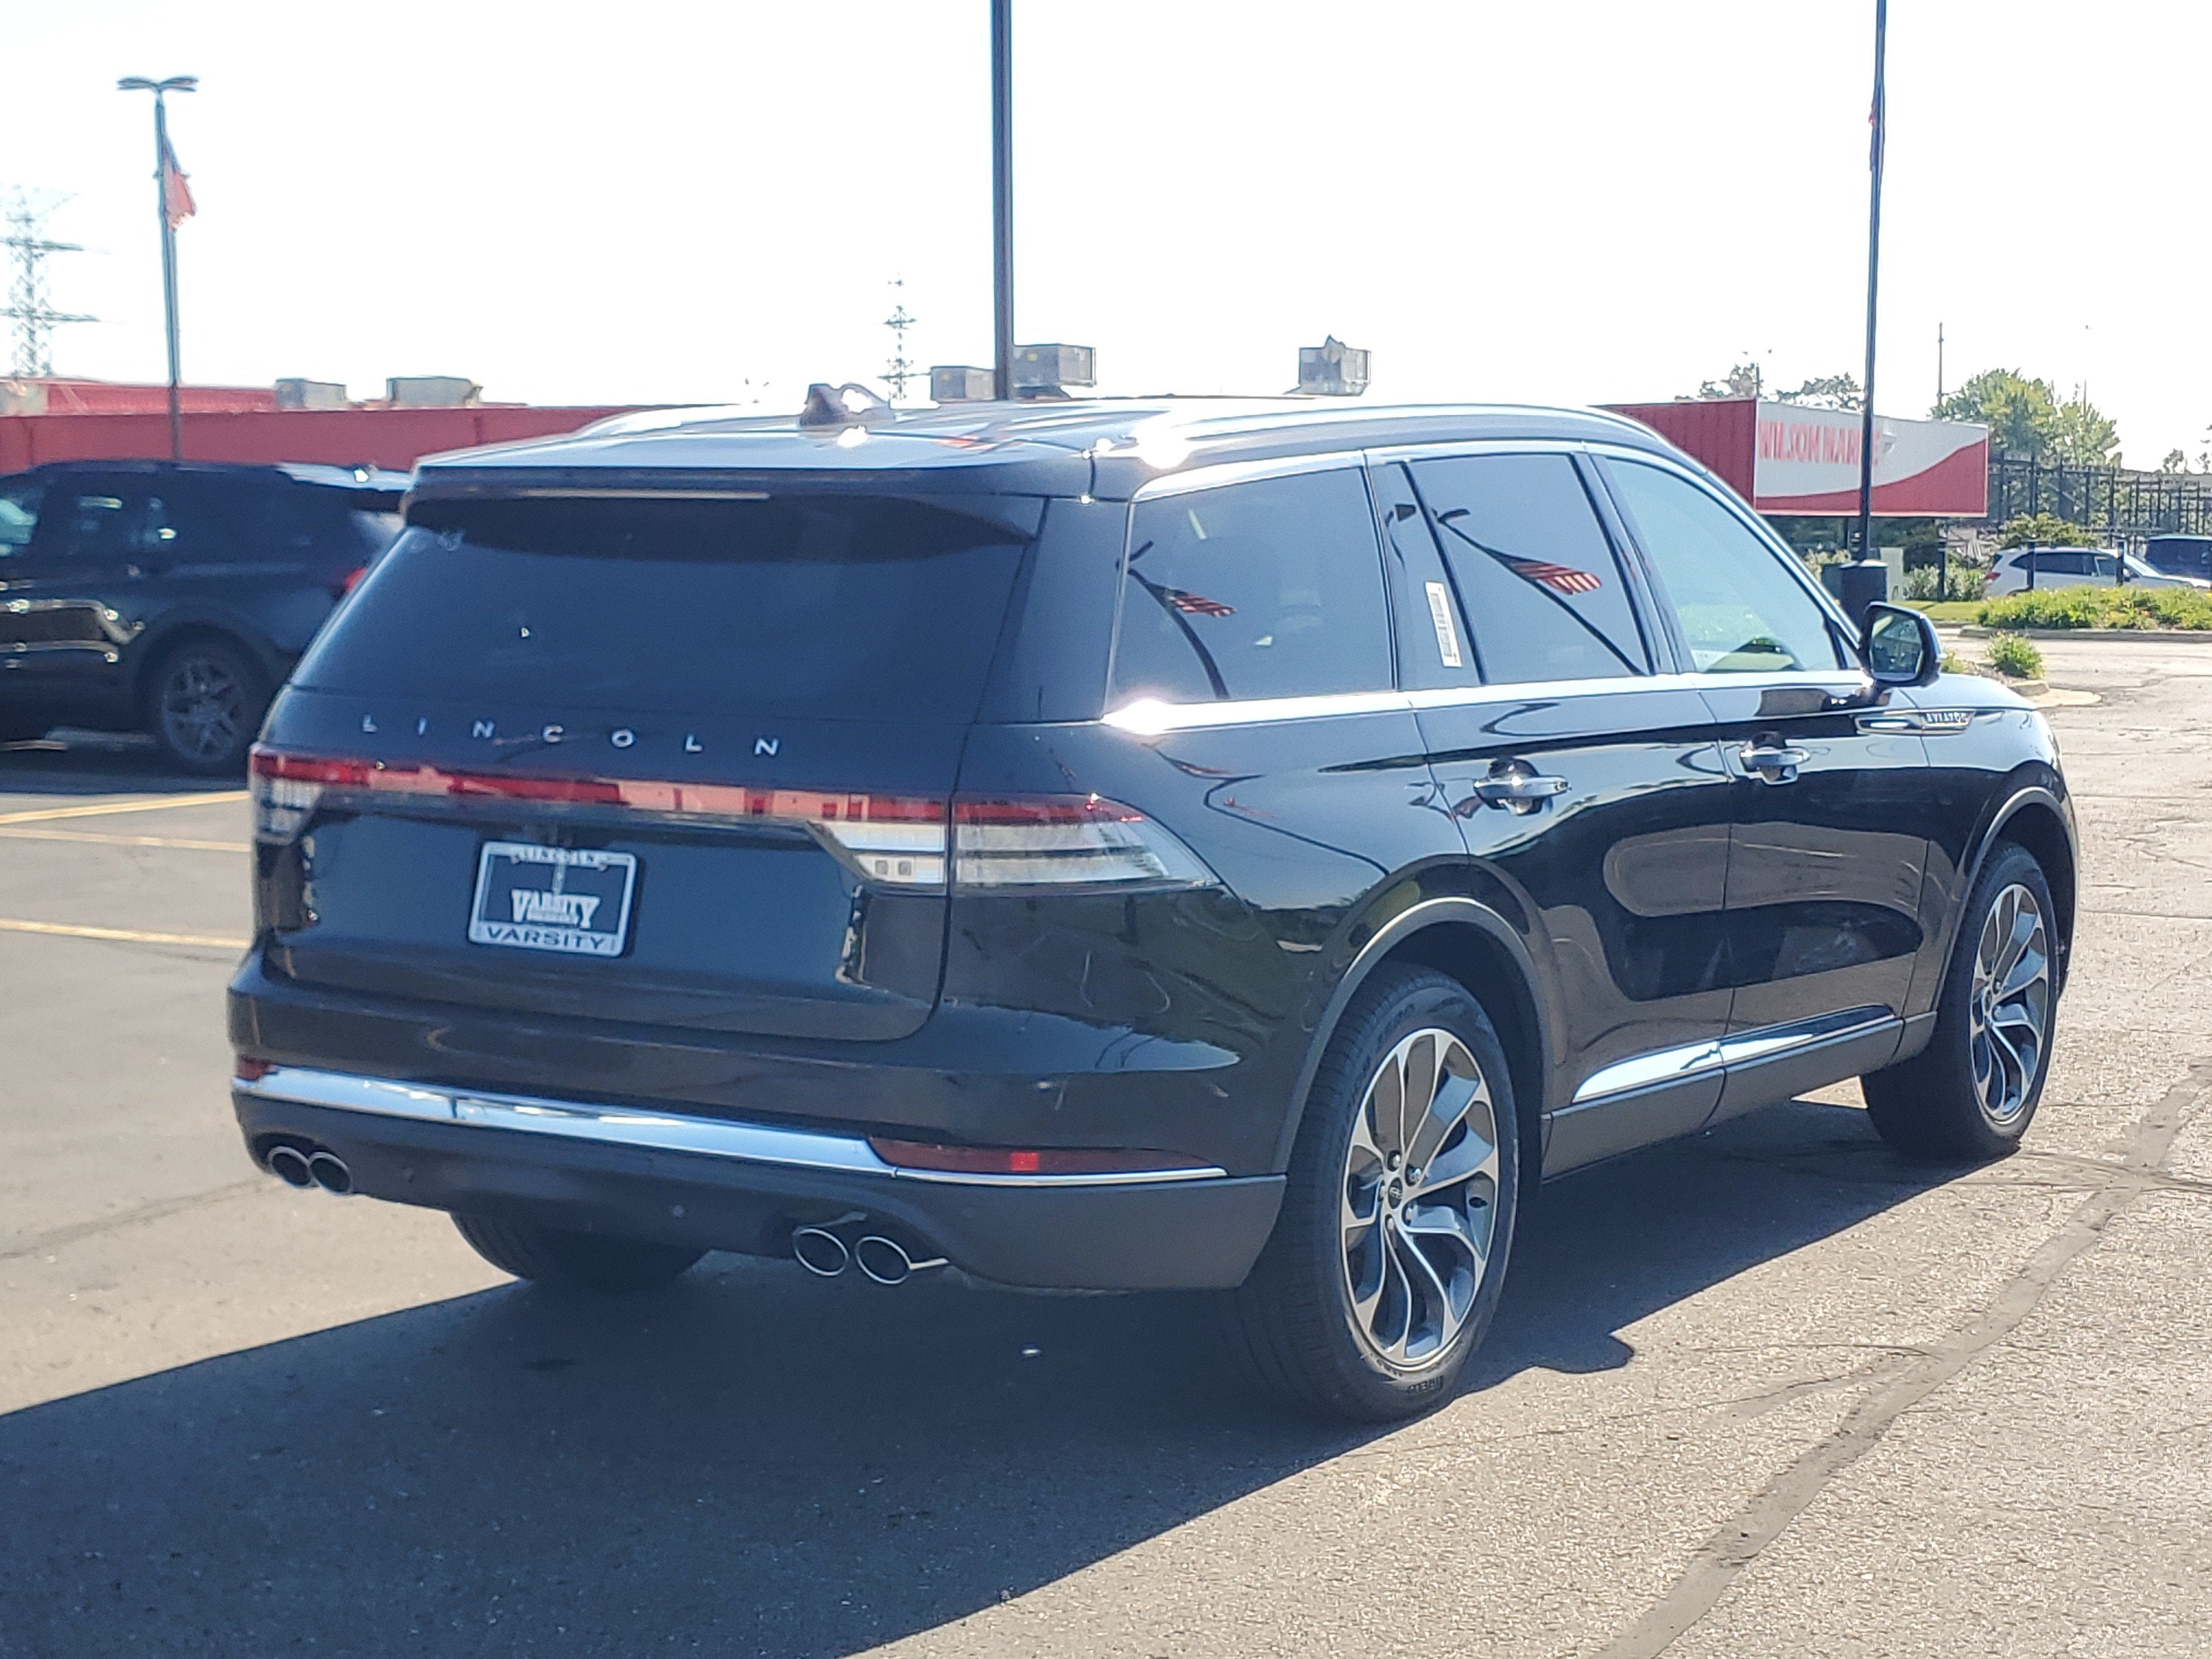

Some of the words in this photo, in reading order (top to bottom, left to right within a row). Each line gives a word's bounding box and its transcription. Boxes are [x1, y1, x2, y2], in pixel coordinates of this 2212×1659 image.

[1758, 420, 1820, 462] WILSON
[362, 714, 780, 755] LINCOLN
[488, 926, 604, 950] VARSITY
